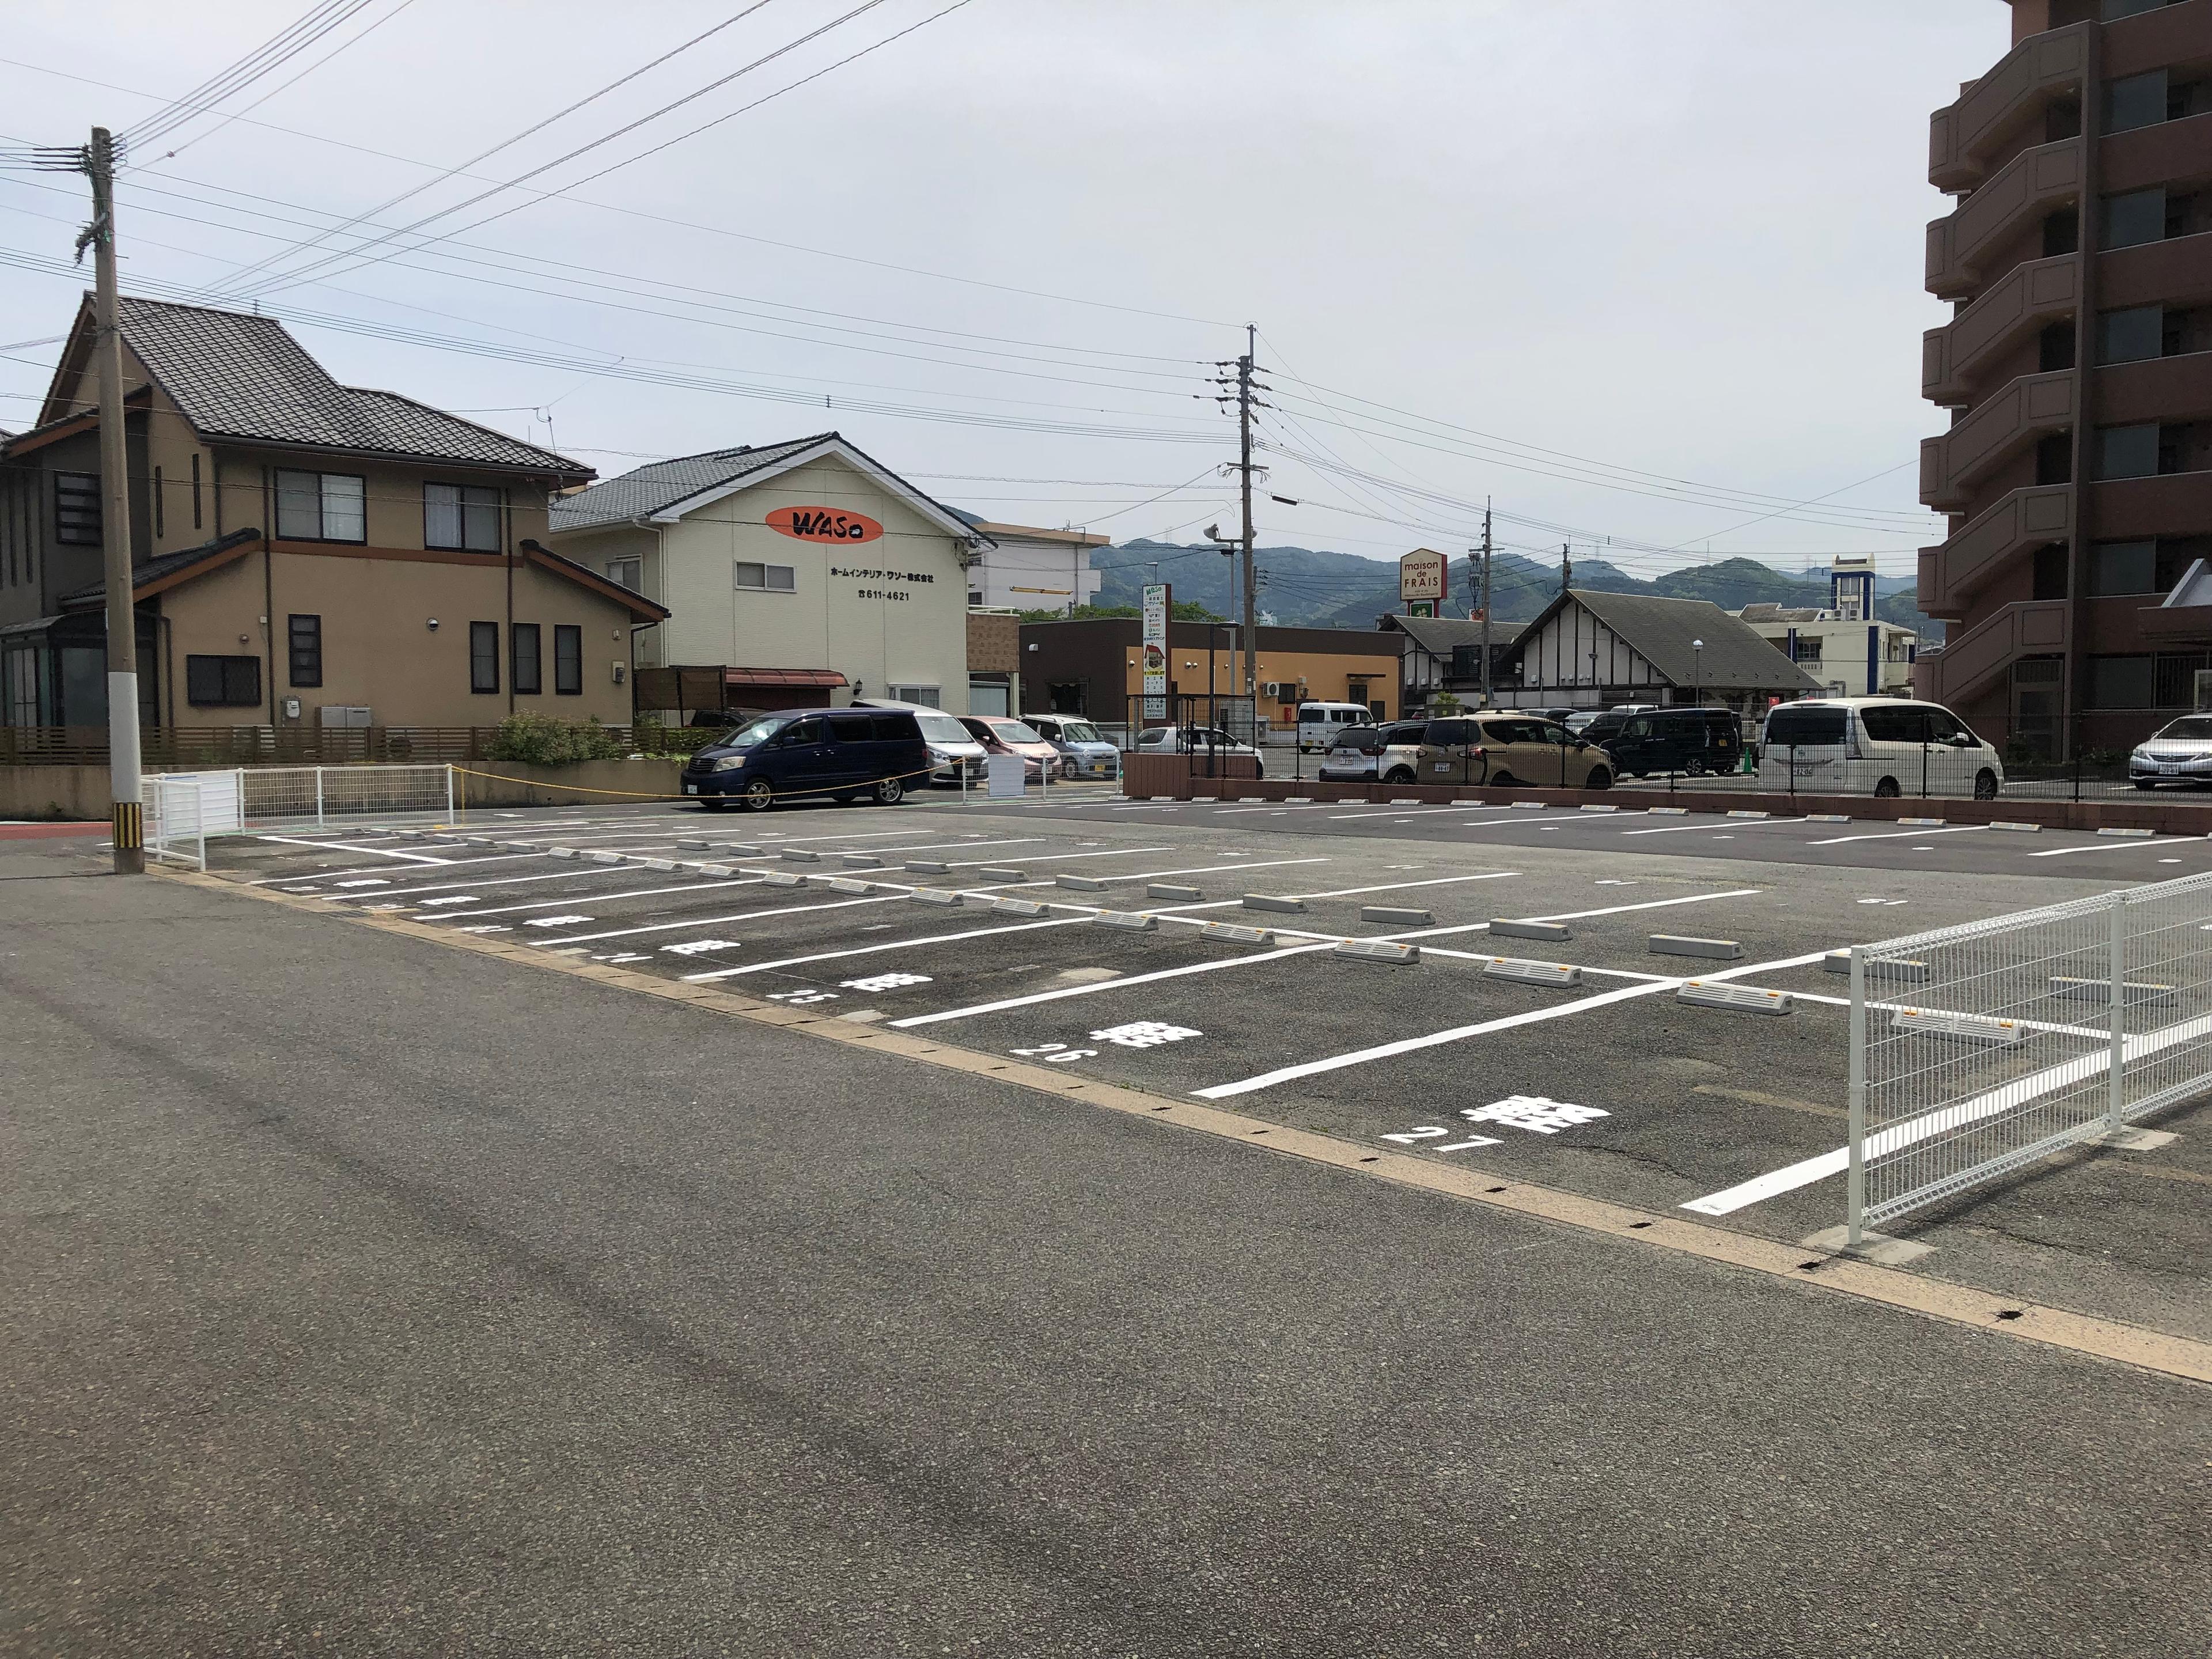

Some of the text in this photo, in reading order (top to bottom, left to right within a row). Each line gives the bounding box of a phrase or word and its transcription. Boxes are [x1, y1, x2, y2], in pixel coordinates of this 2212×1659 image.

[1404, 562, 1438, 571] maison
[1404, 577, 1438, 588] FRAIS
[867, 589, 909, 601] 611-4621
[765, 989, 841, 1003] 25
[1088, 1021, 1205, 1048] 軽
[1008, 1043, 1099, 1063] 26
[1459, 1094, 1613, 1135] 軽
[1378, 1126, 1505, 1152] 27
